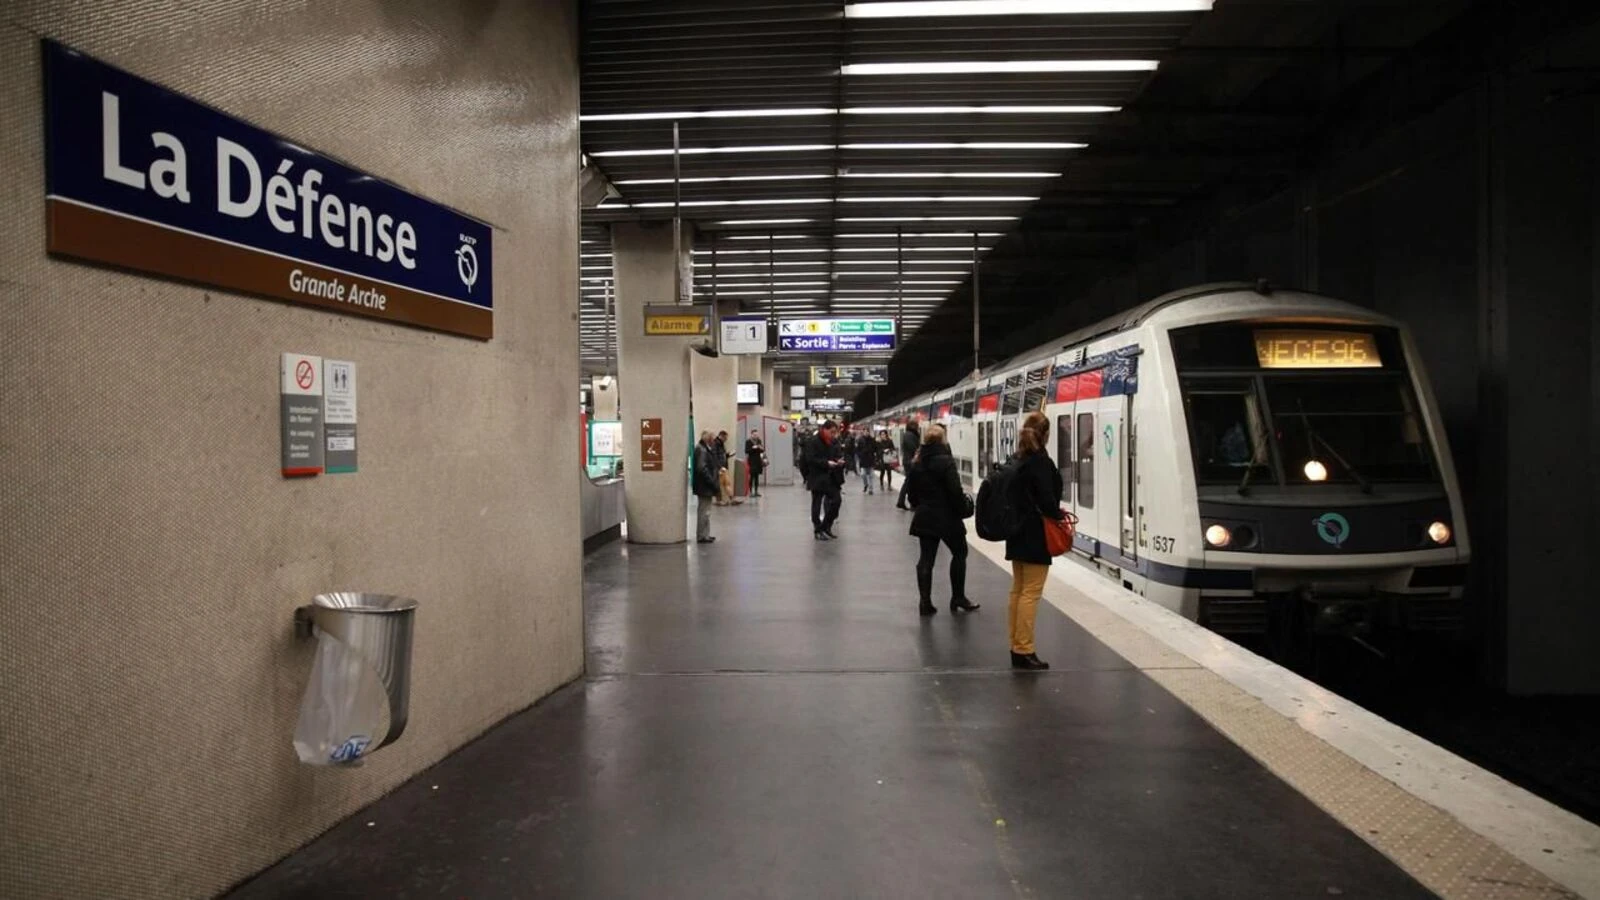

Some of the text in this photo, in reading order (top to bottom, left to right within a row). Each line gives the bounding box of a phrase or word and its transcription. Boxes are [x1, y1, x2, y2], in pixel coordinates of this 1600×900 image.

[102, 90, 417, 270] La Défense
[289, 269, 387, 311] Grande Arche
[651, 320, 693, 330] Alarme
[749, 326, 756, 339] 1
[794, 337, 829, 349] Sortie
[1152, 535, 1175, 554] 1537
